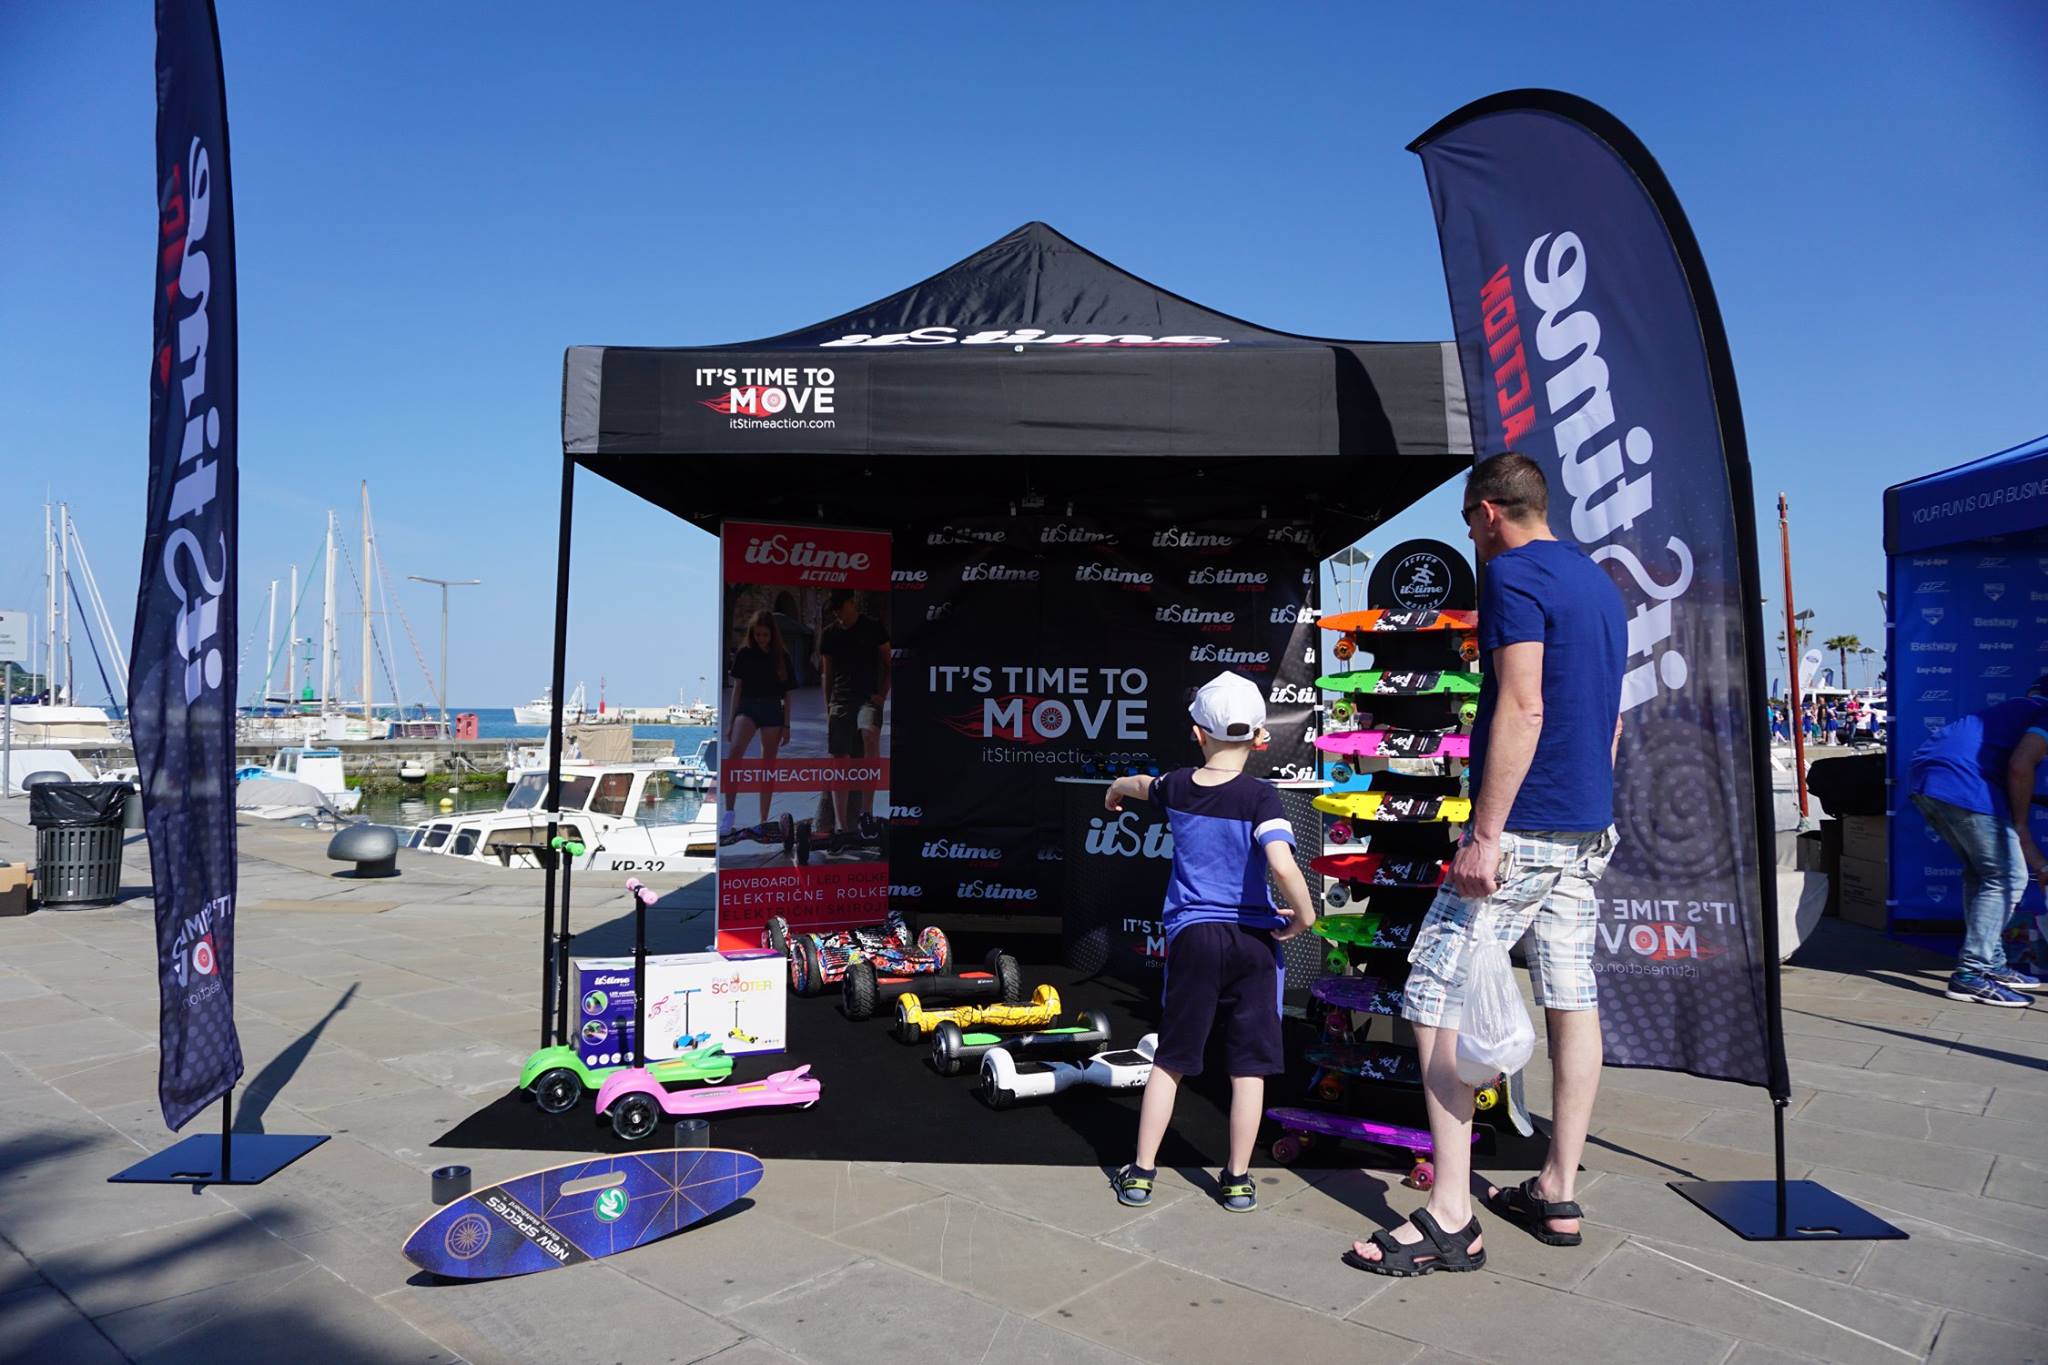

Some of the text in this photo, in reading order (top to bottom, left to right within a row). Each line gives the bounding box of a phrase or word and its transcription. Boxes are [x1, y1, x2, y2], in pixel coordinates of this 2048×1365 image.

[696, 368, 835, 386] IT'S TIME TO
[730, 387, 835, 413] MOVE
[729, 418, 835, 430] itStimeaction.com
[1912, 505, 1939, 524] YOUR
[1941, 500, 1963, 517] FUN
[1965, 496, 1976, 511] IS
[1978, 489, 2004, 509] OUR
[745, 534, 870, 571] itStime
[800, 570, 848, 583] ACTION
[962, 563, 1040, 582] itStime
[1075, 563, 1154, 584] itStime
[1188, 567, 1269, 585] itStime
[1155, 604, 1235, 624] itStime
[1189, 643, 1270, 664] itStime
[1910, 642, 1957, 653] Bestway
[929, 666, 1148, 695] IT'S TIME TO
[983, 698, 1148, 740] MOVE
[730, 768, 881, 783] ITSTIMEACTION.COM
[921, 839, 1002, 860] itStime
[723, 876, 800, 889] HOVBOARDI
[957, 880, 1038, 899] itStime
[723, 886, 887, 906] ELEKTRIČNE ROLKE
[1123, 918, 1151, 934] IT'S
[711, 979, 773, 994] SCOOTER
[486, 1196, 570, 1261] NEW SPECIES
